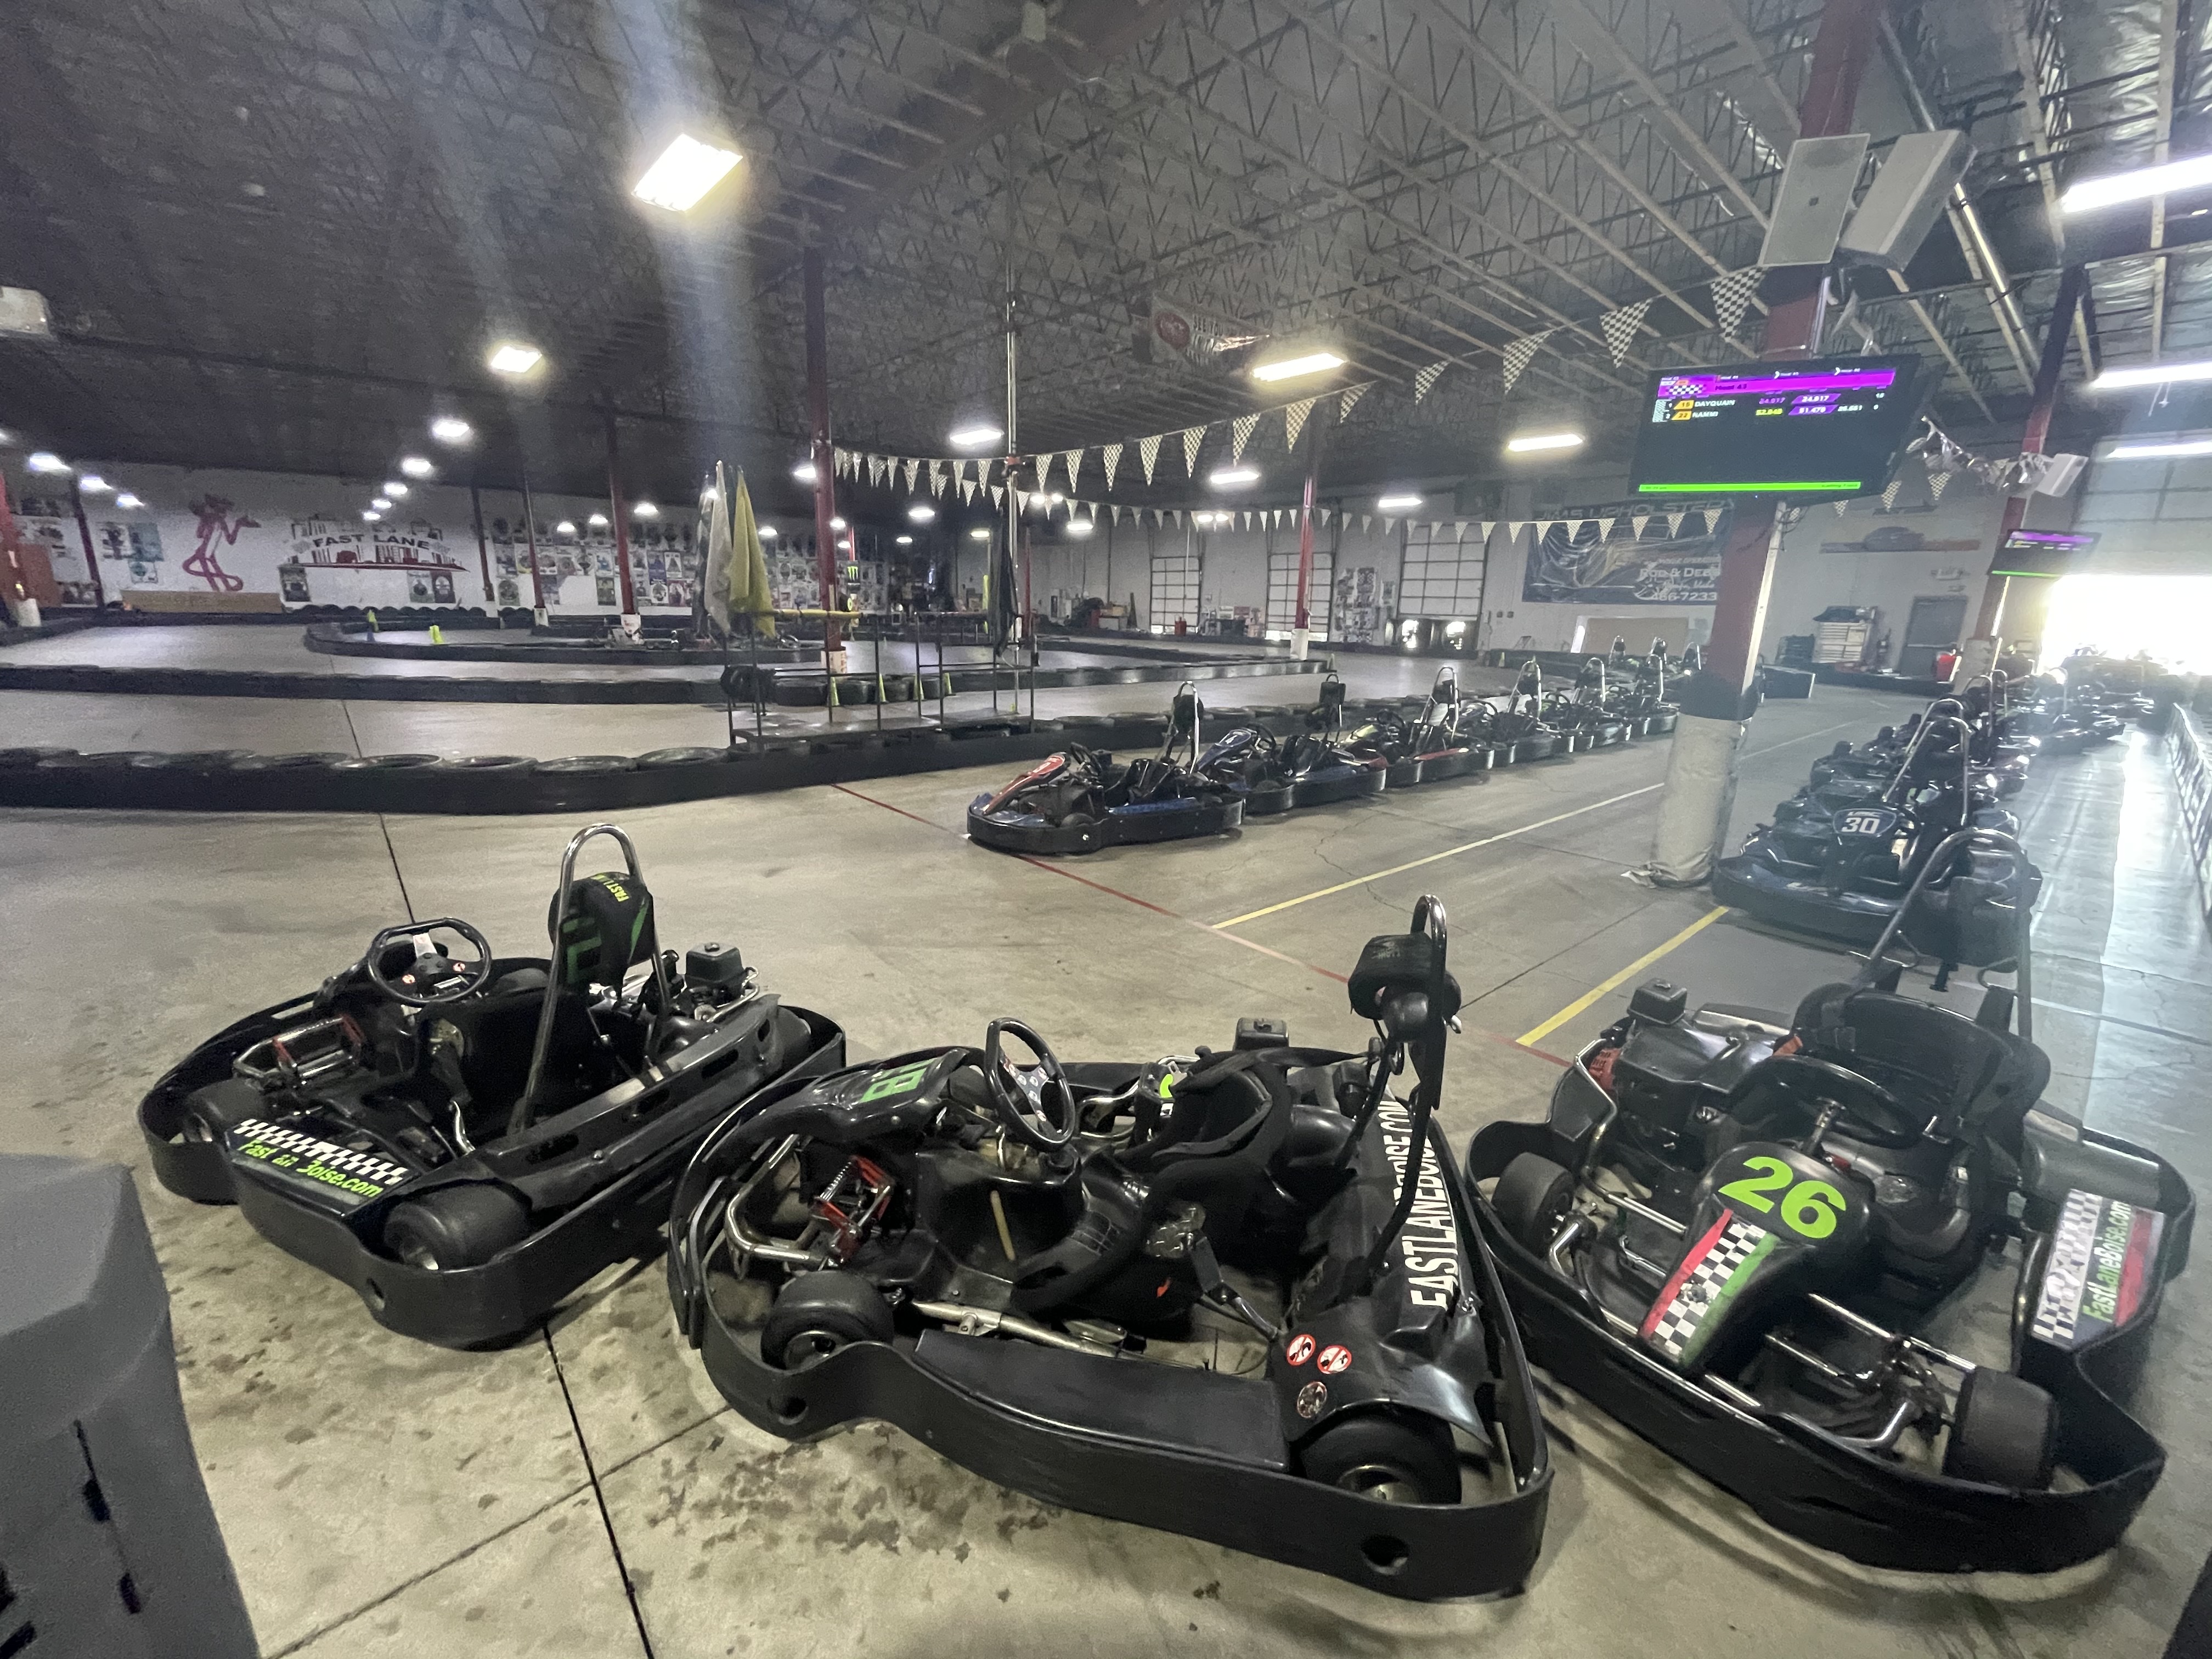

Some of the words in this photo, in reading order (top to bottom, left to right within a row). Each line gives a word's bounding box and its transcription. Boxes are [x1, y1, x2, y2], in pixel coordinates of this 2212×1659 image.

[312, 534, 364, 548] FAST
[373, 534, 430, 549] LANE
[1841, 817, 1880, 834] 30
[237, 1139, 280, 1159] Fast
[1718, 1156, 1847, 1239] 26
[2082, 1200, 2132, 1323] FastLaneBoise.com
